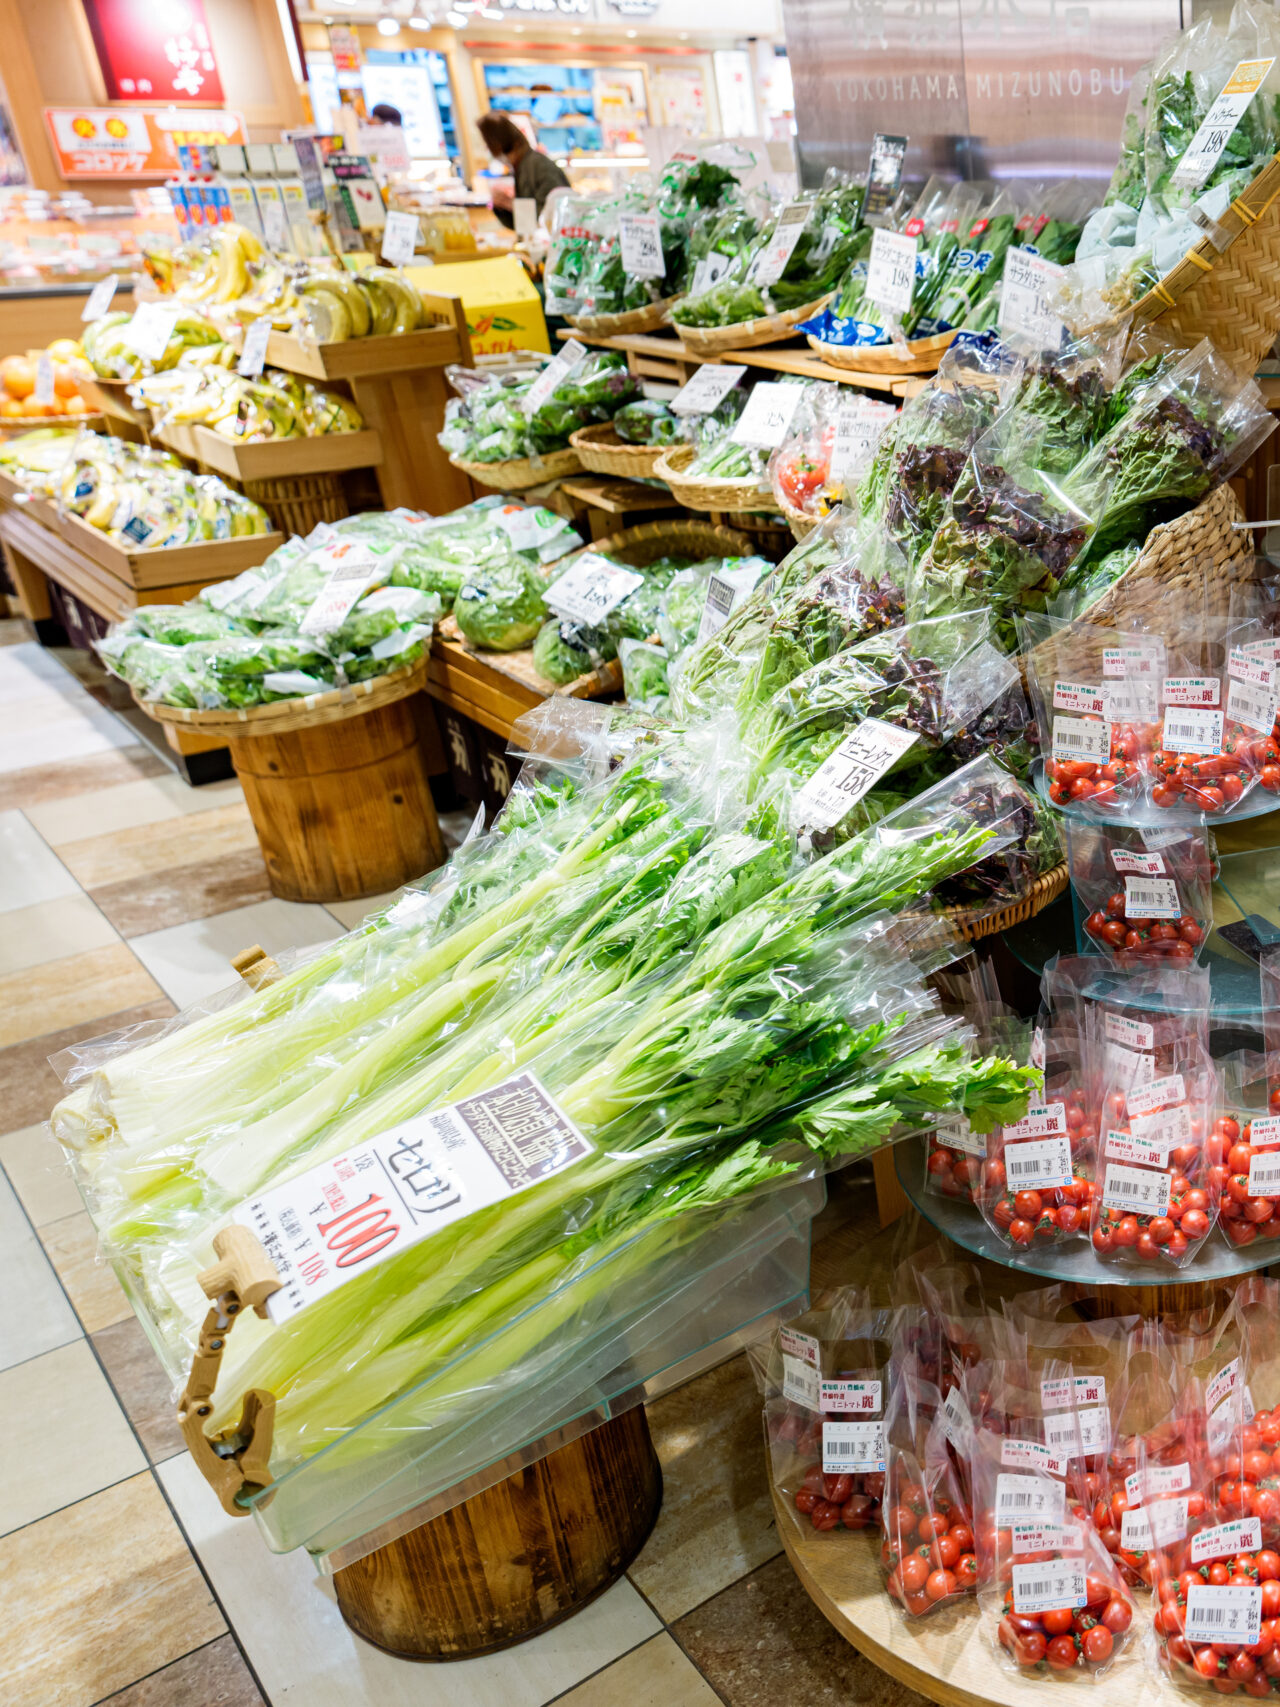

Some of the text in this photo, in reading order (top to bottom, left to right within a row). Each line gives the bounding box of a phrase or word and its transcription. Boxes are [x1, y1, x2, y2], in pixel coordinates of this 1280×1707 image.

[832, 67, 1125, 102] YOKOHAMA MIZUNOBU
[1201, 129, 1229, 153] 198
[836, 766, 875, 796] 158
[388, 1136, 461, 1213] セロリ
[317, 1193, 401, 1268] 100
[297, 1252, 329, 1286] 108
